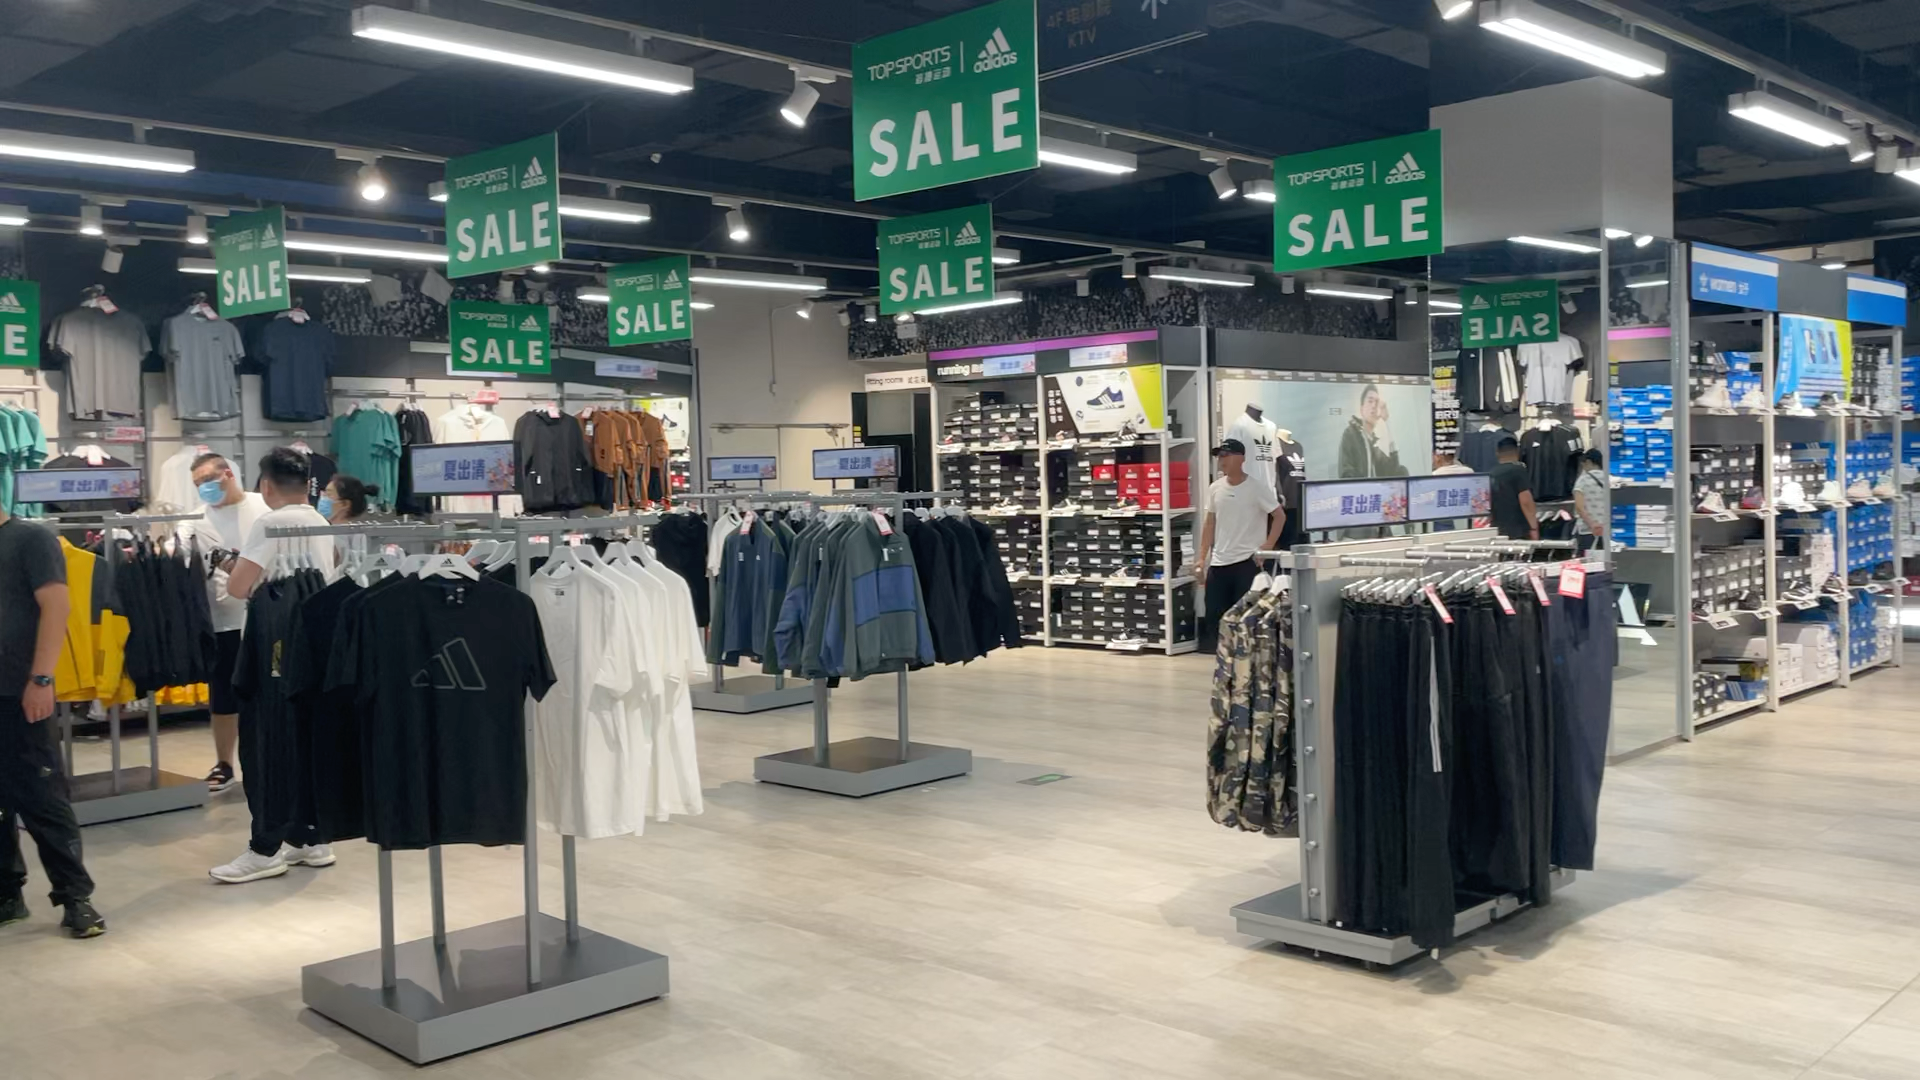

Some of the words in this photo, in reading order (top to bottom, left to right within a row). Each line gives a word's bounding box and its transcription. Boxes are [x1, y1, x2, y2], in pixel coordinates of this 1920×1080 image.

[1068, 26, 1096, 48] KTV
[867, 45, 951, 81] TOPSPORTS
[973, 51, 1018, 74] adidas
[869, 88, 1022, 178] SALE
[1287, 163, 1364, 187] TOPSPORTS
[1385, 170, 1426, 185] adidas
[456, 201, 551, 262] SALE
[888, 228, 941, 245] TOPSPORTS
[1288, 196, 1428, 257] SALE
[222, 260, 282, 306] SALE
[889, 256, 984, 302] SALE
[615, 299, 685, 336] SALE
[460, 337, 544, 366] SALE
[937, 364, 970, 376] running
[1341, 494, 1382, 515] 夏出清
[1436, 488, 1470, 508] 夏出清
